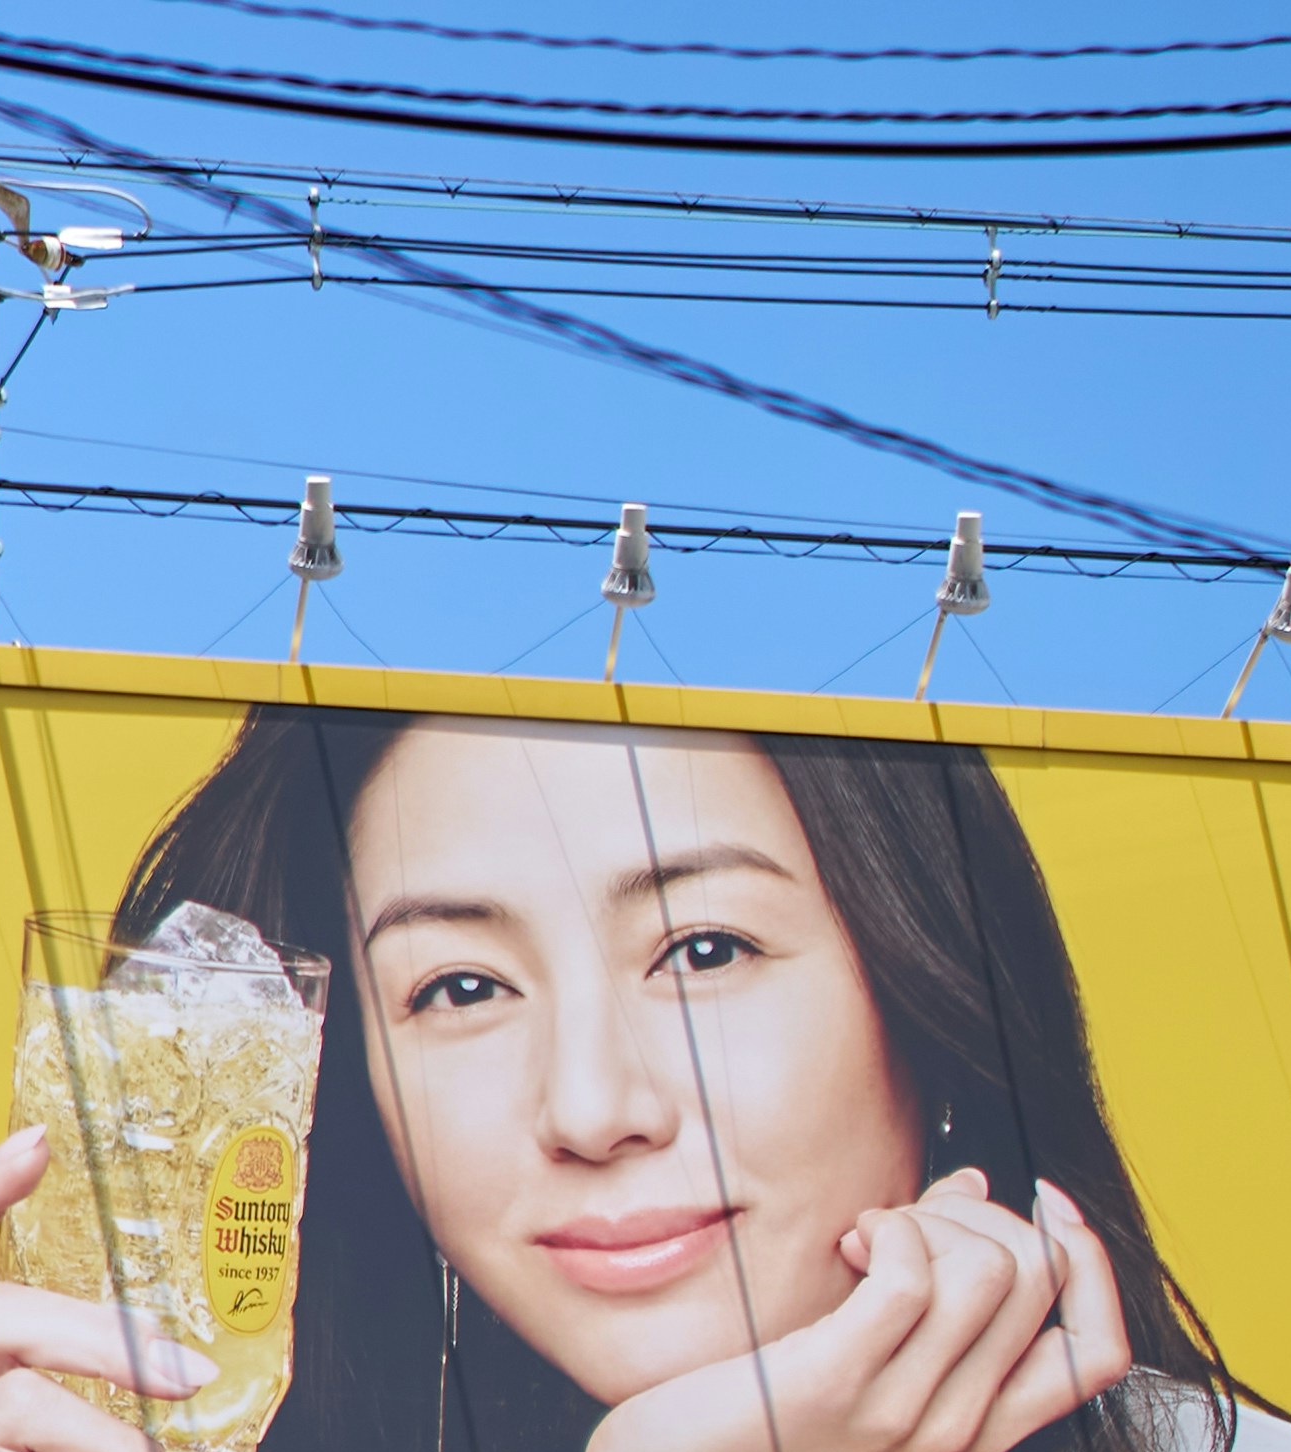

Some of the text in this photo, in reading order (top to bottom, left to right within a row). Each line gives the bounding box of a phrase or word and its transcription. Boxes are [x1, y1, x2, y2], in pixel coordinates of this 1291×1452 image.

[214, 1195, 291, 1229] Suntory
[214, 1227, 287, 1261] Whisky
[217, 1263, 280, 1283] since 1937
